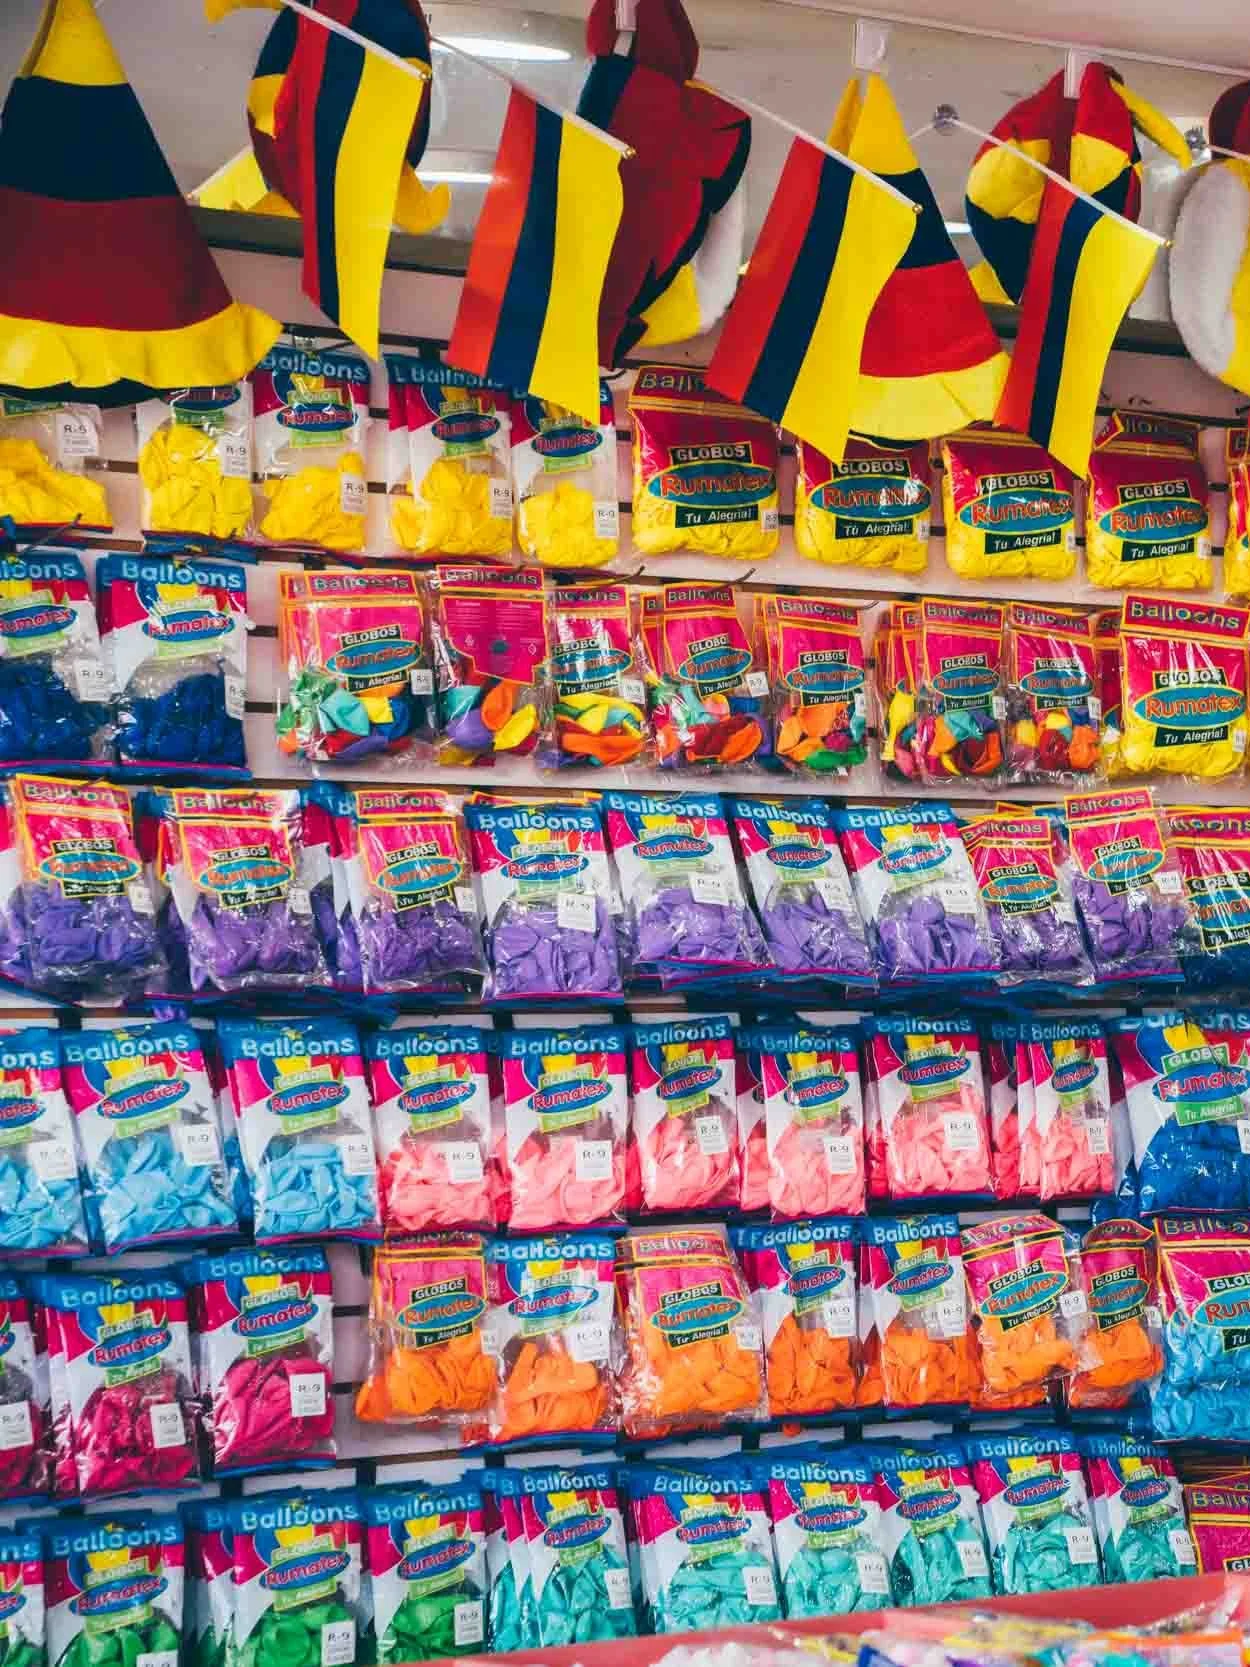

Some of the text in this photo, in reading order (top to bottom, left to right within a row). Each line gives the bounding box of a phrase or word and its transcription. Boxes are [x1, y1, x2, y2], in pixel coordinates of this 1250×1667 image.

[676, 445, 746, 461] GLOBOS
[839, 461, 904, 473] GLOBOS
[986, 474, 1049, 490] GLOBOS
[1125, 483, 1185, 499] GLOBOS
[972, 501, 1073, 524] Rumatex
[994, 540, 1008, 550] Tu
[122, 559, 242, 589] Balloons
[1131, 603, 1240, 630] Balloons
[345, 627, 397, 645] GLOBOS
[336, 645, 416, 669] Rumatex
[804, 652, 846, 663] GLOBOS
[944, 655, 984, 667] GLOBOS
[1146, 693, 1241, 718] Rumatex
[1165, 733, 1179, 743] Tu
[609, 791, 717, 816] Balloons
[479, 813, 595, 831] Balloons
[736, 803, 826, 826] Balloons
[848, 809, 950, 826] Balloons
[638, 839, 706, 857] Rumatex
[1098, 840, 1138, 858] GLOBOS
[992, 865, 1037, 878] GLOBOS
[636, 1022, 726, 1046] Balloons
[877, 1016, 972, 1034] Balloons
[1032, 1023, 1099, 1040] Balloons
[65, 1033, 188, 1062] Balloons
[242, 1038, 355, 1058] Balloons
[375, 1032, 479, 1056] Balloons
[511, 1034, 619, 1054] Balloons
[763, 1032, 849, 1051] Balloons
[903, 1058, 965, 1083] Rumatex
[660, 1069, 718, 1093] Rumatex
[1158, 1069, 1246, 1102] Rumatex
[103, 1081, 184, 1116] Rumatex
[271, 1084, 344, 1114] Rumatex
[403, 1083, 470, 1108] Rumatex
[532, 1083, 607, 1110] Rumatex
[1185, 1109, 1198, 1119] Tu
[700, 1125, 720, 1135] R-9
[950, 1122, 971, 1132] R-9
[348, 1144, 368, 1152] R-9
[452, 1151, 475, 1160] R-9
[583, 1150, 606, 1160] R-9
[830, 1145, 849, 1153] R-9
[764, 1222, 849, 1245] Balloons
[874, 1219, 958, 1243] Balloons
[211, 1255, 323, 1277] Balloons
[787, 1267, 840, 1295] Rumatex
[889, 1266, 950, 1293] Rumatex
[992, 1263, 1040, 1291] GLOBOS
[1096, 1267, 1135, 1288] GLOBOS
[62, 1280, 177, 1308] Balloons
[415, 1279, 464, 1299] GLOBOS
[665, 1284, 718, 1304] GLOBOS
[987, 1274, 1058, 1314] Rumatex
[1064, 1296, 1079, 1305] R-9
[237, 1302, 312, 1333] Rumatex
[829, 1307, 850, 1316] R-9
[943, 1306, 963, 1316] R-9
[95, 1332, 168, 1363] Rumatex
[1232, 1334, 1247, 1347] Tu
[298, 1383, 320, 1392] R-9
[981, 1437, 1071, 1457] Balloons
[770, 1463, 866, 1482] Balloons
[871, 1455, 959, 1470] Balloons
[523, 1472, 608, 1493] Balloons
[653, 1475, 752, 1493] Balloons
[1006, 1479, 1070, 1505] Rumatex
[242, 1503, 357, 1529] Balloons
[375, 1494, 477, 1519] Balloons
[679, 1517, 748, 1539] Rumatex
[53, 1524, 176, 1556] Balloons
[1071, 1534, 1090, 1545] R-9
[401, 1541, 470, 1572] Rumatex
[266, 1553, 346, 1584] Rumatex
[77, 1578, 162, 1609] Rumatex
[459, 1612, 479, 1621] R-9
[328, 1633, 351, 1642] R-9
